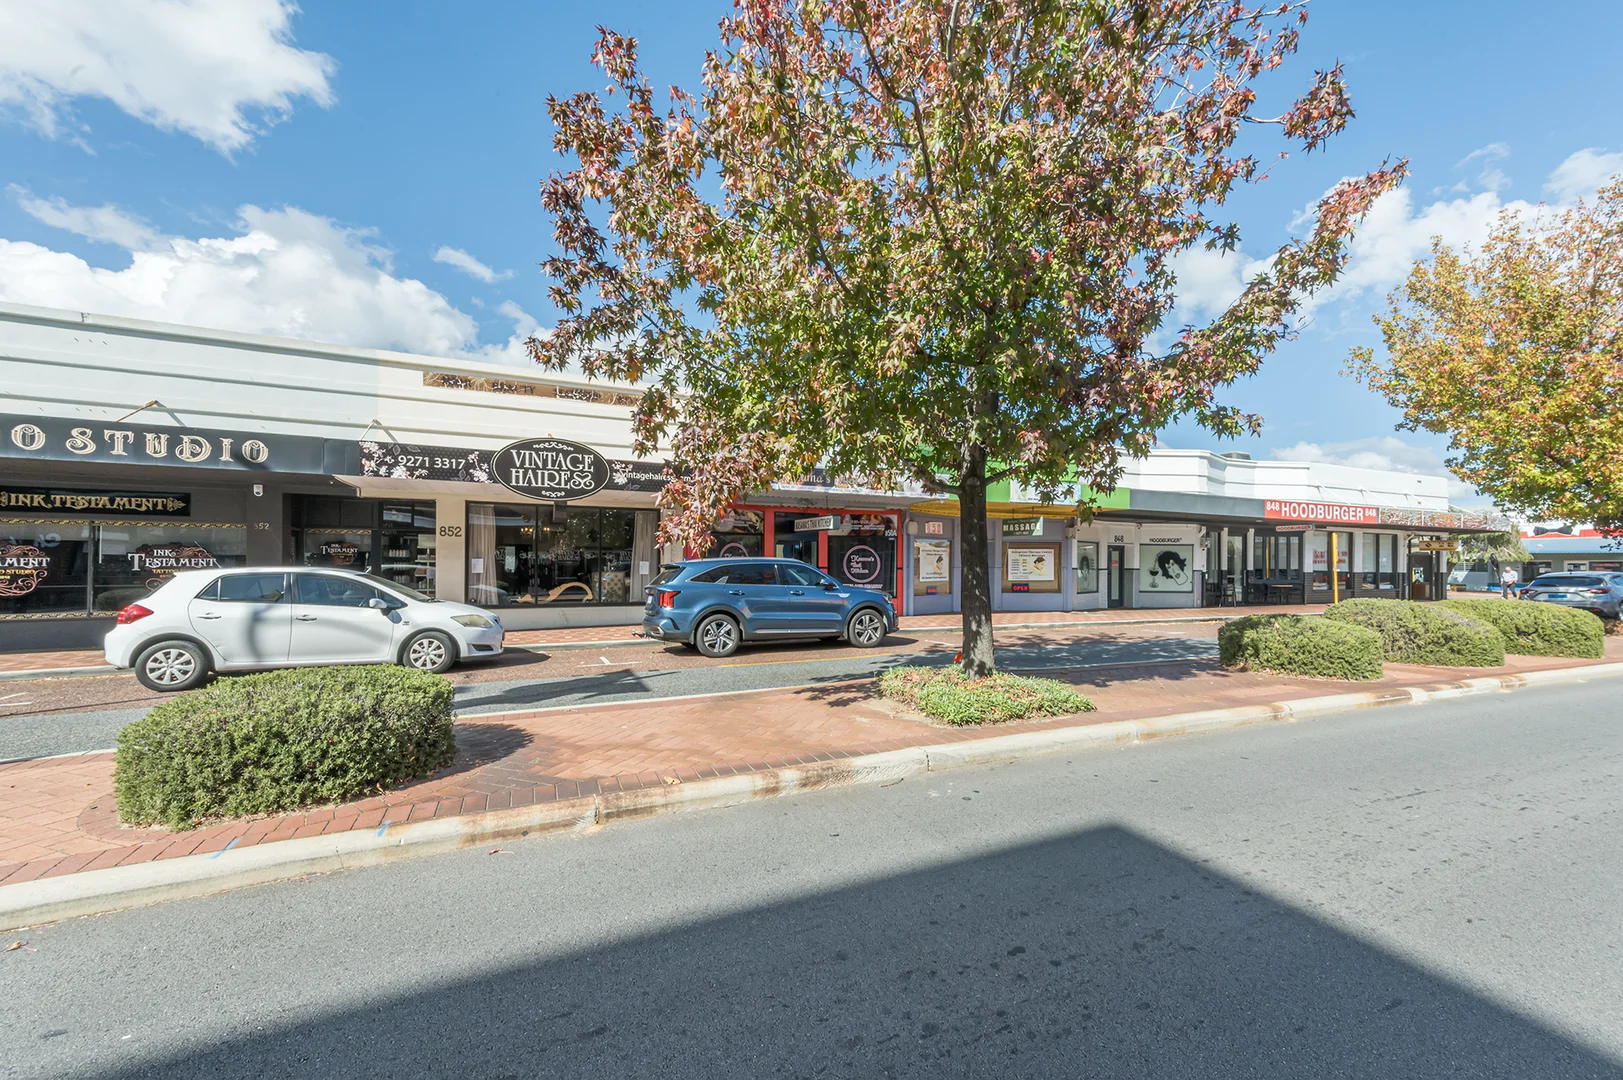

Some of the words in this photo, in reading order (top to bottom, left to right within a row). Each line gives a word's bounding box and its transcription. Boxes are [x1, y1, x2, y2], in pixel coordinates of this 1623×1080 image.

[10, 424, 46, 451] O
[65, 427, 269, 464] STUDIO
[399, 455, 430, 467] 9271
[433, 457, 466, 470] 3317
[510, 450, 594, 476] VINTAGE
[10, 492, 50, 509] INK
[50, 494, 167, 512] TESTAMENT
[1266, 502, 1280, 511] 848
[1281, 502, 1364, 521] HOODBURGER
[1365, 509, 1377, 518] 848
[438, 526, 462, 538] 852
[926, 523, 942, 533] 850
[1003, 523, 1041, 532] MASSAGE
[1114, 535, 1125, 543] 848
[153, 549, 172, 558] INK
[0, 557, 50, 569] MENT
[127, 553, 216, 571] TESTAMENT
